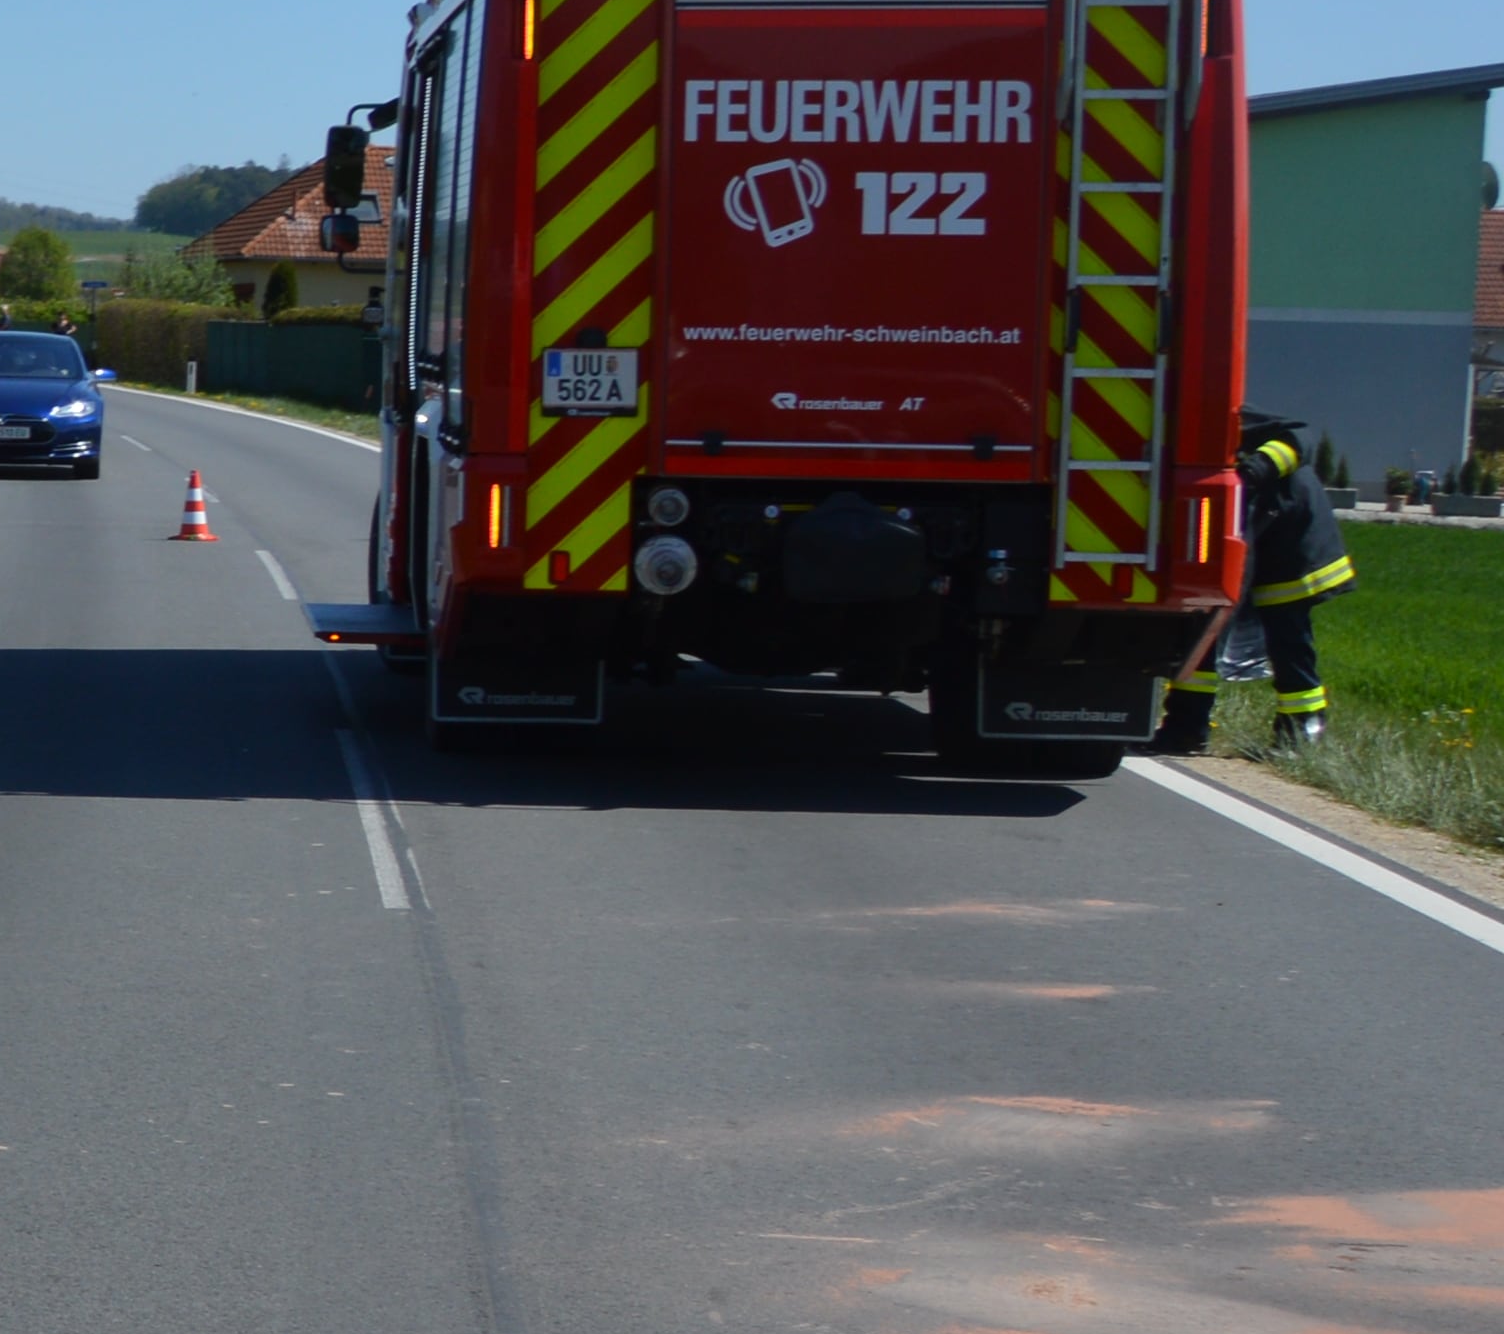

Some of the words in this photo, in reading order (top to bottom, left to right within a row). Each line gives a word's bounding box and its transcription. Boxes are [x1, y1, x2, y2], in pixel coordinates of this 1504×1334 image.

[684, 79, 1033, 144] FEUERWEHR
[855, 171, 987, 236] 122
[682, 323, 1022, 345] www.feuerwehr-schweinbach.at
[573, 354, 603, 377] UU
[558, 378, 601, 402] 562
[606, 378, 623, 402] A
[799, 395, 884, 411] rosenbauer
[899, 396, 926, 411] AT
[1035, 707, 1130, 723] rosenbauer
